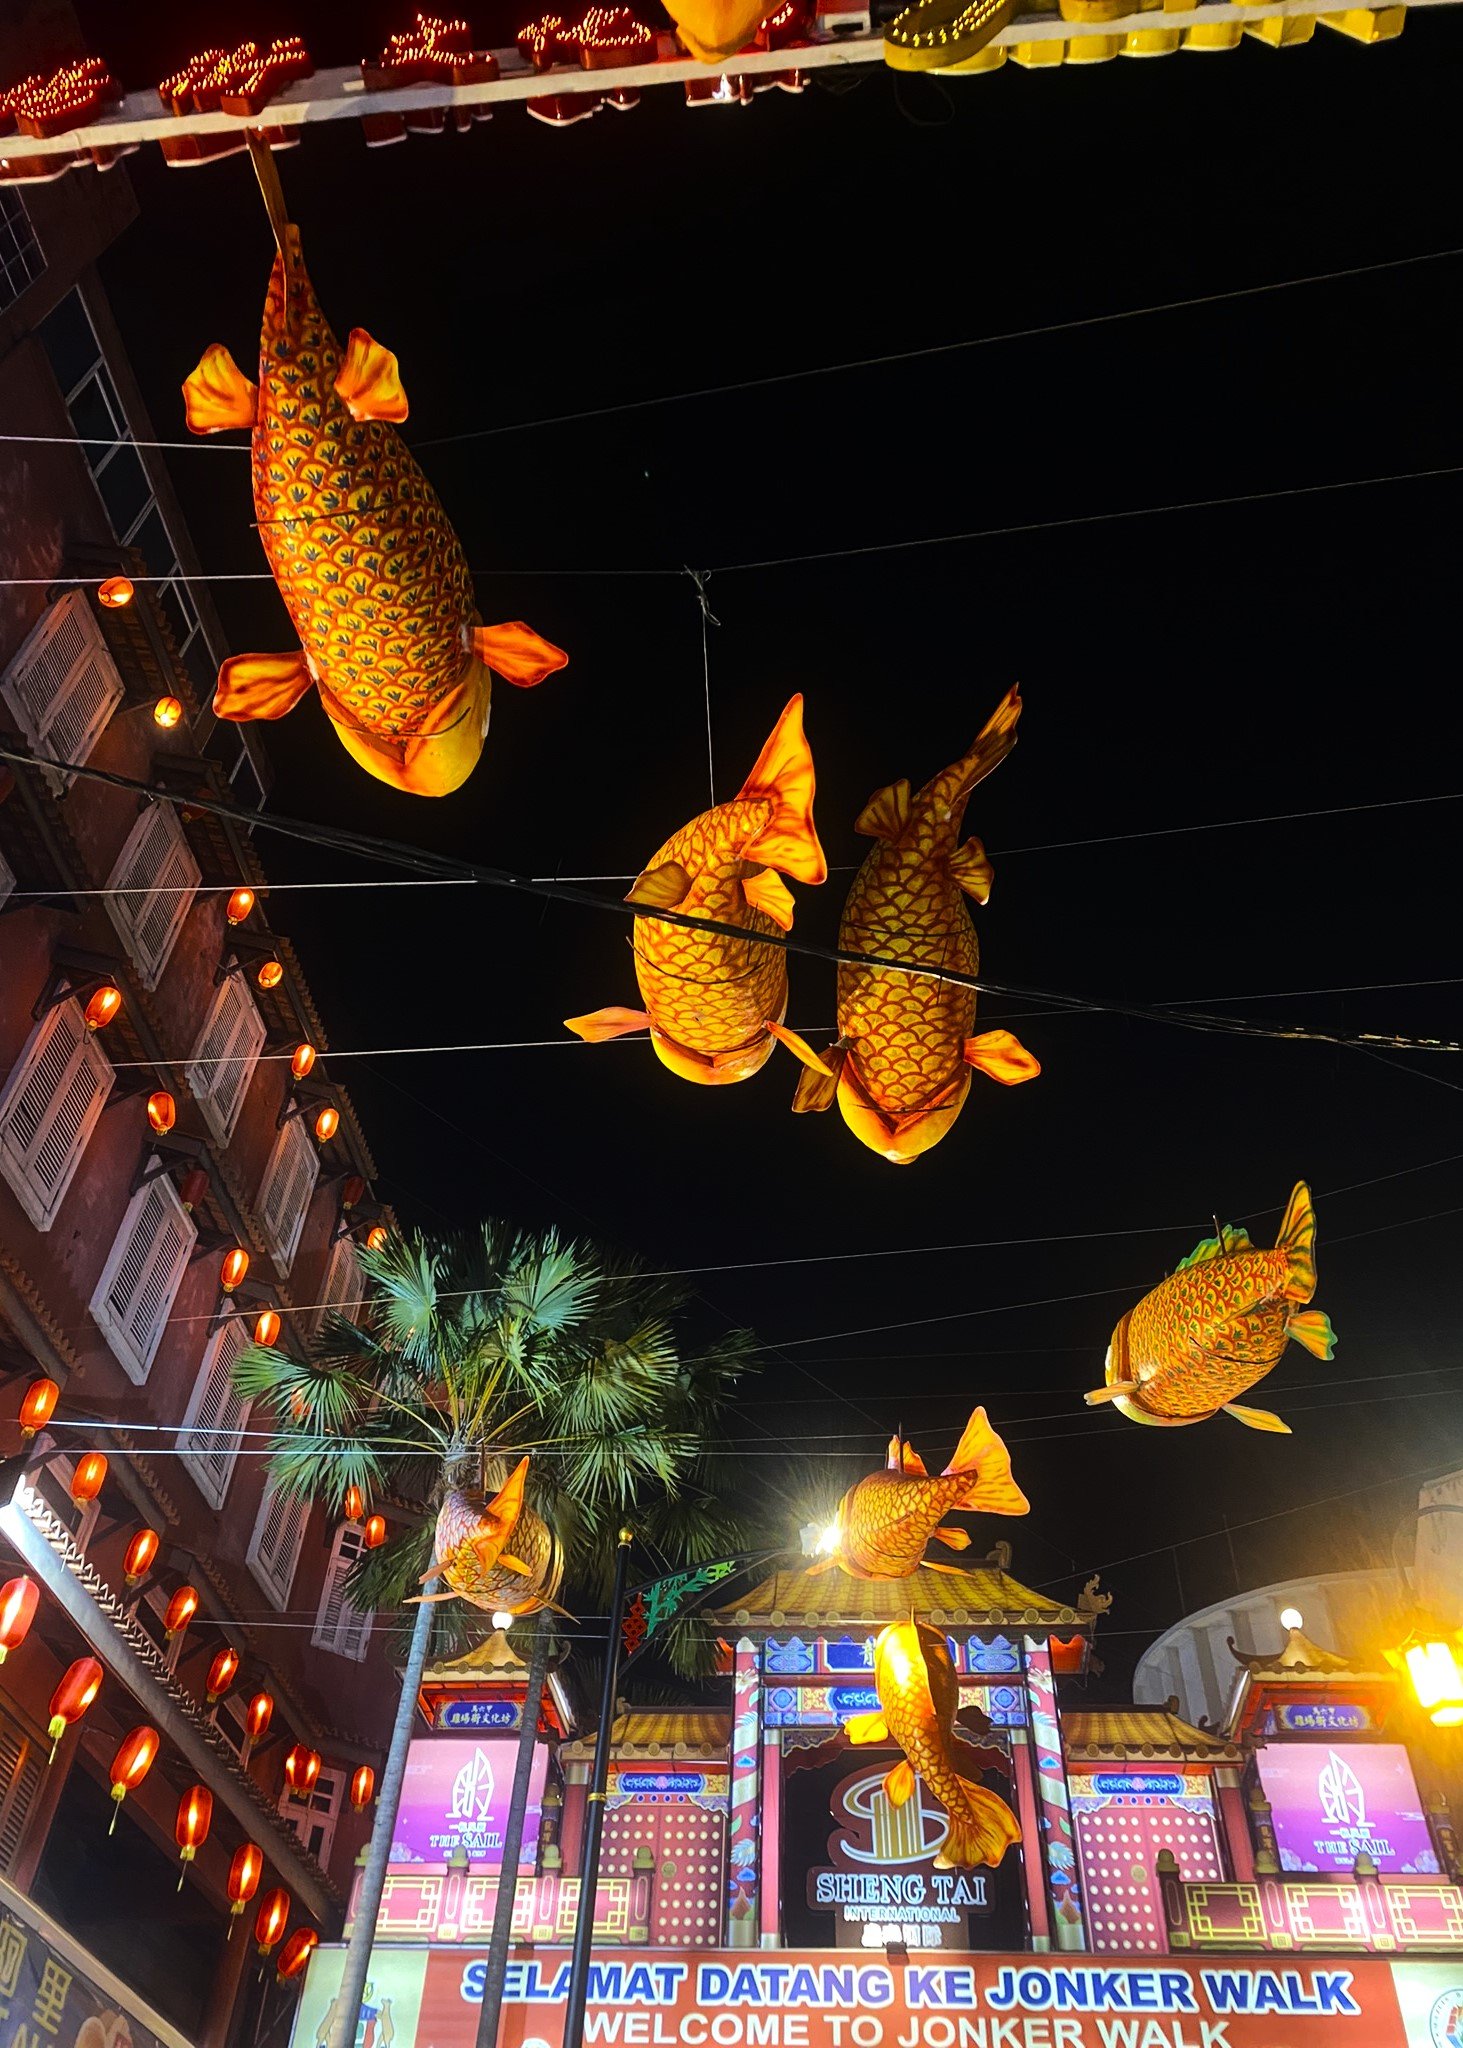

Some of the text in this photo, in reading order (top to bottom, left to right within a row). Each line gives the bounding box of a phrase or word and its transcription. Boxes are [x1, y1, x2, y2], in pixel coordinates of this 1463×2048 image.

[462, 1832, 503, 1849] SAIL
[816, 1873, 988, 1906] SHENG TAI
[843, 1904, 962, 1923] INTERNATIONAL
[461, 1961, 1361, 2014] SELAMAT DATANG KE JONKER WALK
[583, 2012, 1230, 2048] WELCOME TO JONKER WALK
